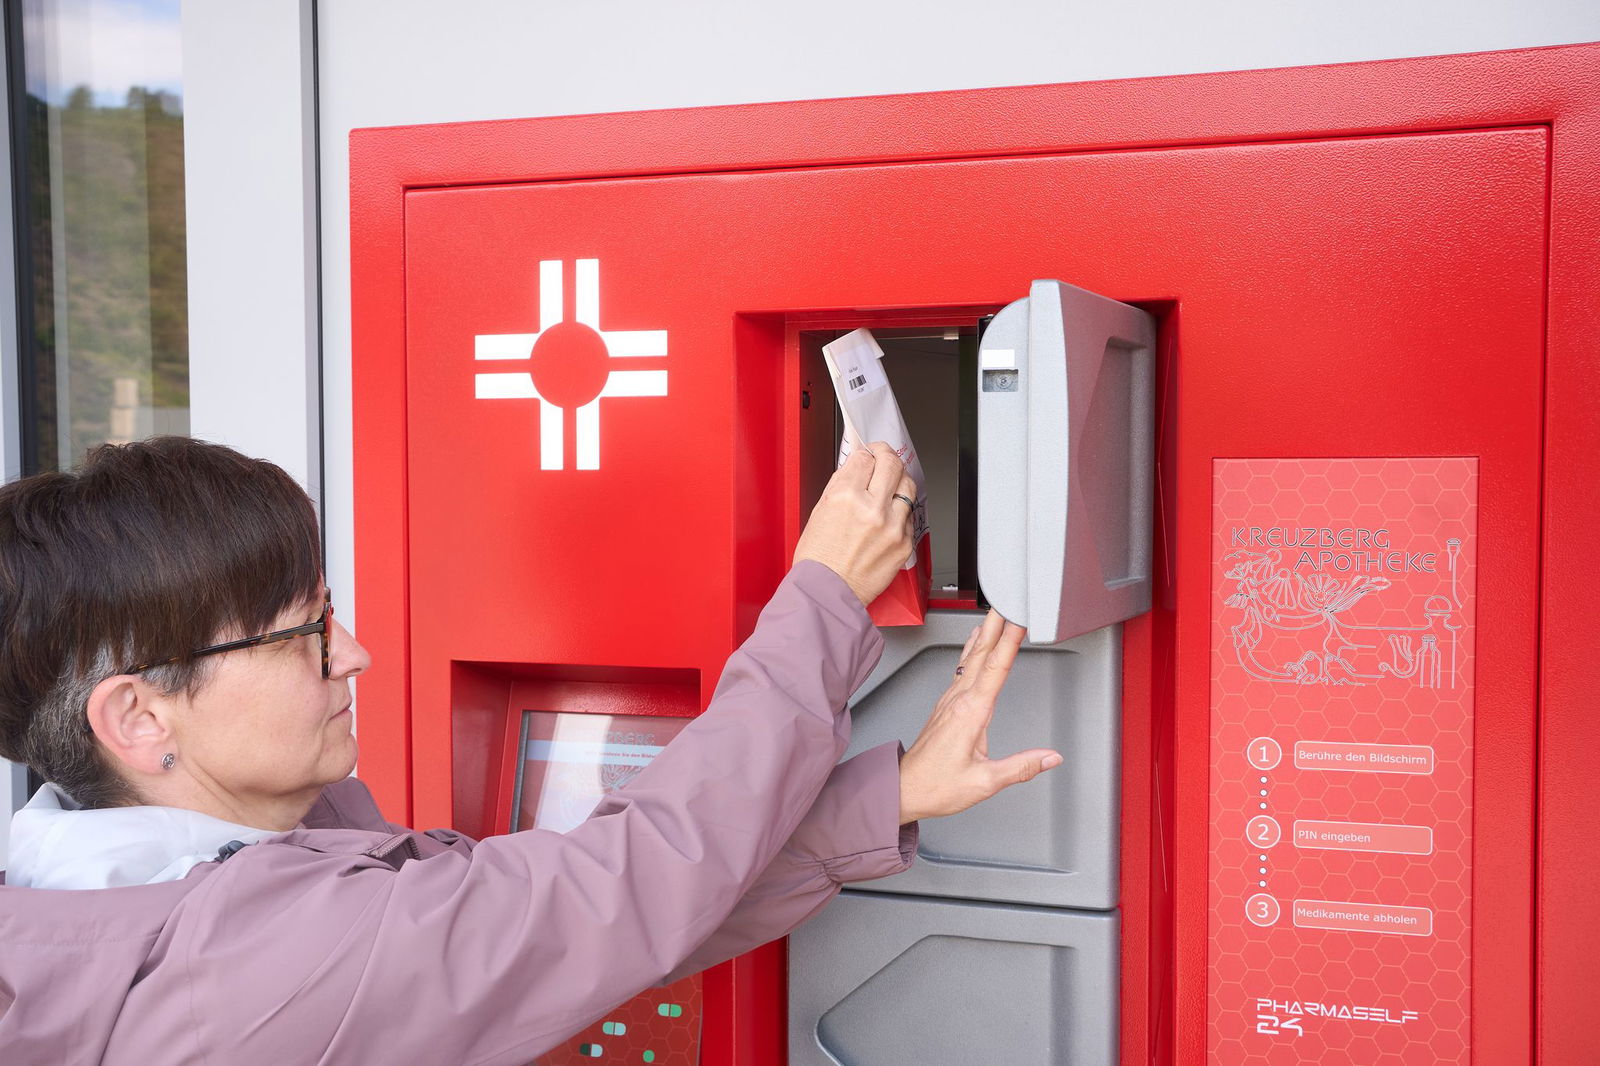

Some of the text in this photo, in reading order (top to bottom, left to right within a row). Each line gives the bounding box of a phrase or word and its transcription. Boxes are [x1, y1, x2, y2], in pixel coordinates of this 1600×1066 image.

[1231, 526, 1390, 549] KREUZBERG
[1294, 551, 1437, 572] APOTHEKE
[1258, 745, 1427, 765] 1 Berühre den Bildschirm
[1257, 823, 1371, 843] 2 PIN eingeben
[1256, 901, 1417, 925] 3 Medikamente abholen
[1256, 998, 1419, 1024] PHARMASELF
[1256, 1014, 1303, 1037] 24
